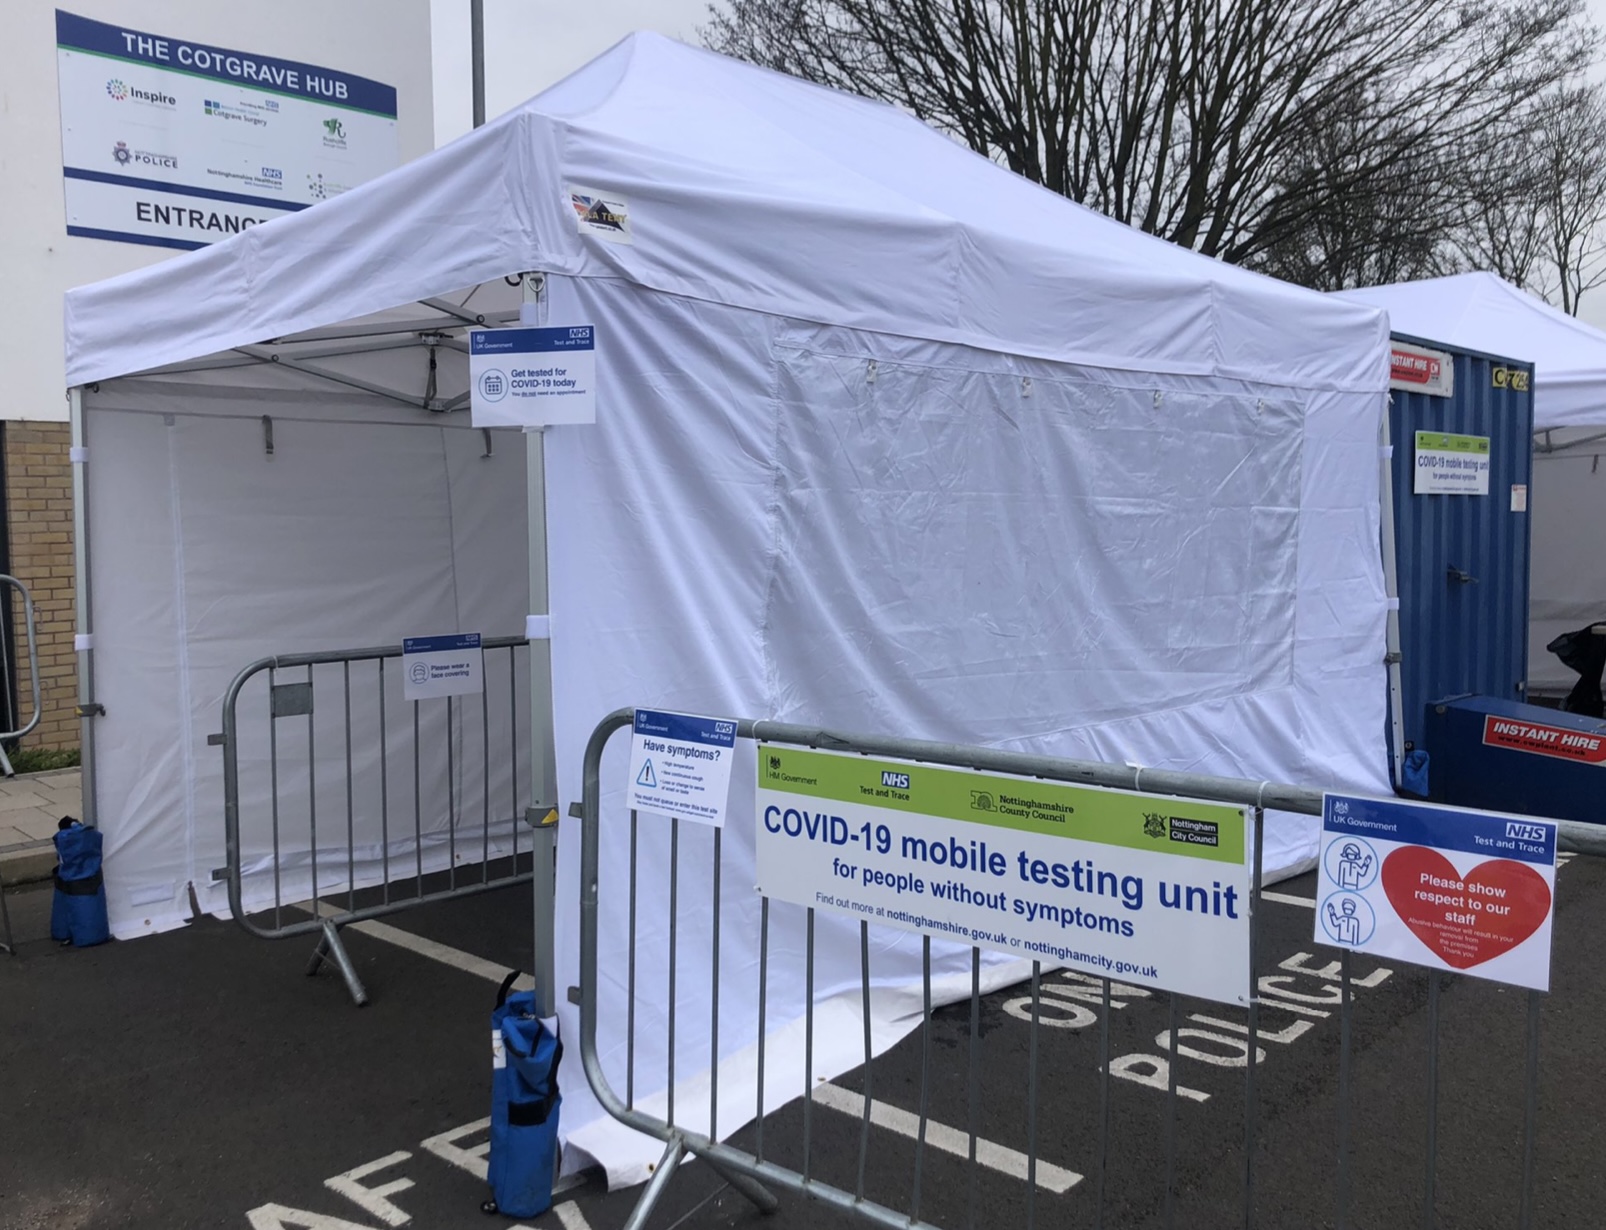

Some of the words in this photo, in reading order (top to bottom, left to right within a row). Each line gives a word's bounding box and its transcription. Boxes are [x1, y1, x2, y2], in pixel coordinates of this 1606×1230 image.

[122, 32, 170, 61] THE
[177, 46, 300, 90] COTGRAVE
[306, 74, 349, 100] HUB
[131, 86, 176, 105] Inspire
[213, 109, 242, 120] Cotgrave
[243, 114, 267, 127] Surgery
[135, 154, 178, 169] POLICE
[207, 168, 253, 181] Nottinghamshire
[254, 176, 282, 186] Healthcare
[263, 167, 282, 180] NHS
[136, 201, 269, 234] ENTRANC
[570, 328, 590, 338] NHS
[1391, 353, 1414, 371] NSTANT
[1414, 358, 1427, 372] HIRE
[511, 369, 526, 378] Get
[527, 368, 554, 378] tested
[555, 367, 567, 377] for
[511, 379, 551, 389] COVID-19
[553, 378, 577, 388] today
[557, 389, 586, 397] appointment
[1418, 455, 1445, 469] COVID-19
[1446, 457, 1462, 469] mobile
[1463, 459, 1478, 472] testing
[444, 669, 470, 678] covering
[645, 724, 668, 732] Government
[715, 722, 733, 734] NHS
[1493, 721, 1559, 743] INSTANT
[1561, 734, 1601, 751] HIRE
[719, 734, 731, 742] Trace
[643, 738, 666, 753] Have
[667, 744, 721, 762] symptoms?
[673, 762, 695, 771] temperature
[769, 771, 780, 781] HM
[780, 773, 818, 786] Government
[882, 771, 909, 789] NHS
[859, 785, 874, 797] Test
[875, 787, 889, 798] and
[890, 790, 910, 801] Trace
[661, 797, 674, 807] queue
[679, 801, 691, 810] enter
[691, 803, 700, 811] this
[700, 805, 709, 813] test
[709, 807, 718, 815] site
[1000, 795, 1074, 815] Nottinghamshire
[1000, 805, 1030, 821] County
[1032, 809, 1066, 823] Council
[1172, 818, 1216, 834] Nottingham
[1333, 815, 1346, 825] UK
[1347, 817, 1398, 833] Government
[1507, 823, 1545, 842] NHS
[1172, 830, 1187, 843] City
[1187, 833, 1217, 845] Council
[1473, 834, 1494, 847] Test
[1496, 838, 1515, 850] and
[1518, 841, 1546, 854] Trace
[764, 804, 891, 855] COVID-19
[901, 836, 1007, 877] mobile
[1017, 850, 1144, 911] testing
[1158, 880, 1239, 920] unit
[1419, 872, 1464, 892] Please
[1468, 881, 1506, 898] show
[833, 857, 857, 880] for
[862, 867, 925, 894] people
[930, 880, 1007, 912] without
[1013, 897, 1135, 938] symptoms
[1414, 891, 1464, 910] respect
[1468, 897, 1482, 910] to
[1486, 902, 1511, 916] our
[1444, 910, 1476, 926] staff
[815, 891, 834, 906] Find
[836, 897, 850, 910] out
[851, 902, 874, 915] more
[876, 907, 885, 918] at
[886, 908, 1008, 946] nottinghamshire.gov.uk
[1010, 937, 1022, 948] or
[1024, 939, 1158, 979] nottinghamcity.gov.uk
[1408, 916, 1431, 928] Abusive
[1432, 919, 1462, 935] behaviour
[1462, 926, 1473, 937] will
[1474, 929, 1491, 940] result
[1492, 932, 1499, 941] in
[1499, 935, 1514, 945] your
[1439, 930, 1463, 942] removal
[1464, 934, 1479, 944] from
[1439, 936, 1449, 947] the
[1450, 940, 1478, 953] premises
[1442, 945, 1461, 957] Thank
[1462, 949, 1475, 960] you
[1099, 952, 1394, 1102] POLICE
